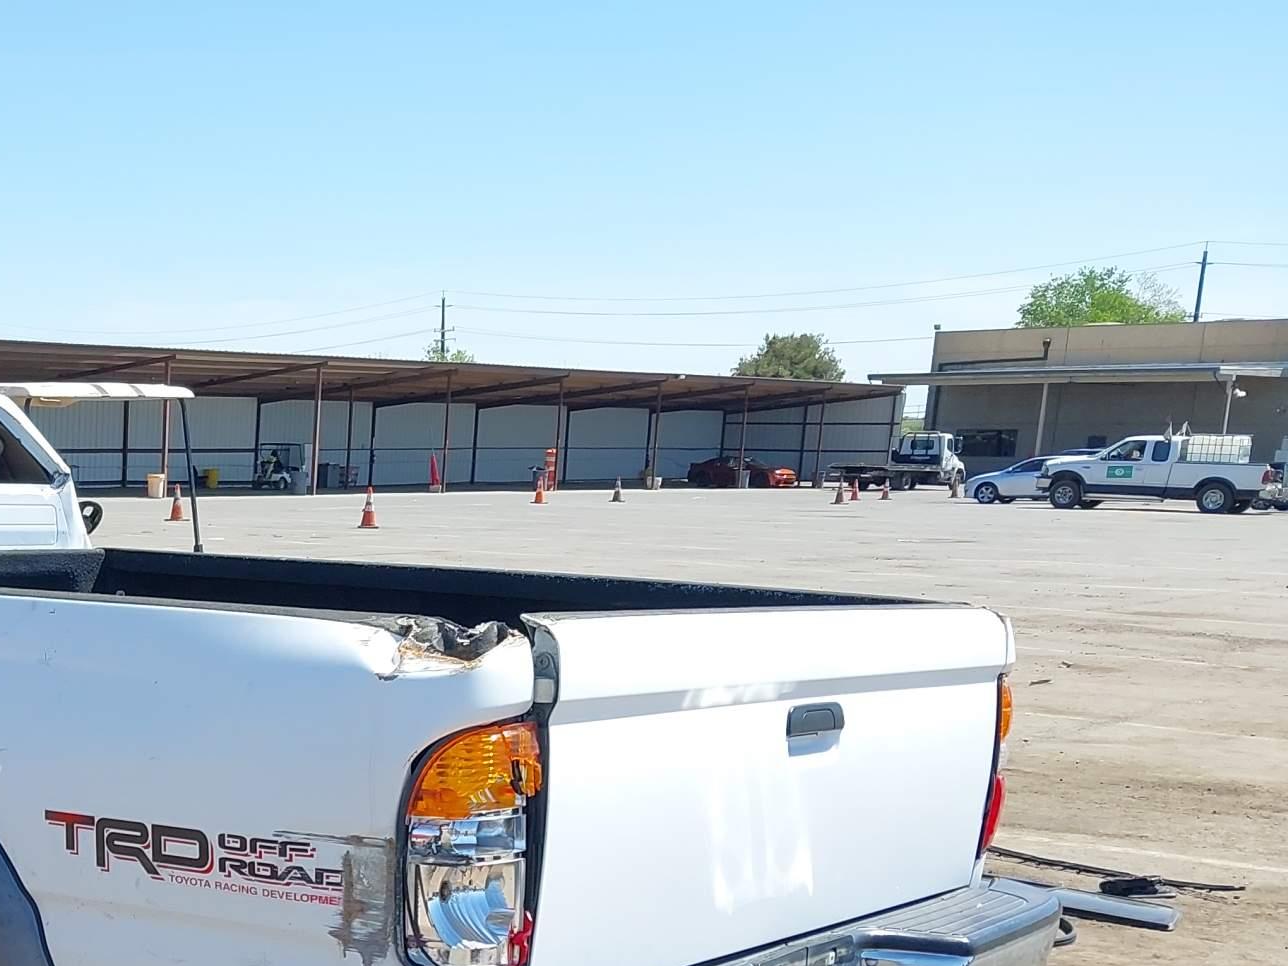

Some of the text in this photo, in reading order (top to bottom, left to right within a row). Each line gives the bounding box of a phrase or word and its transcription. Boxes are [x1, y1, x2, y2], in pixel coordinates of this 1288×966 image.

[45, 809, 213, 881] TRD
[218, 833, 316, 862] OFF
[168, 874, 211, 889] TOYOTA
[215, 881, 258, 896] RACING
[218, 857, 345, 891] ROAD
